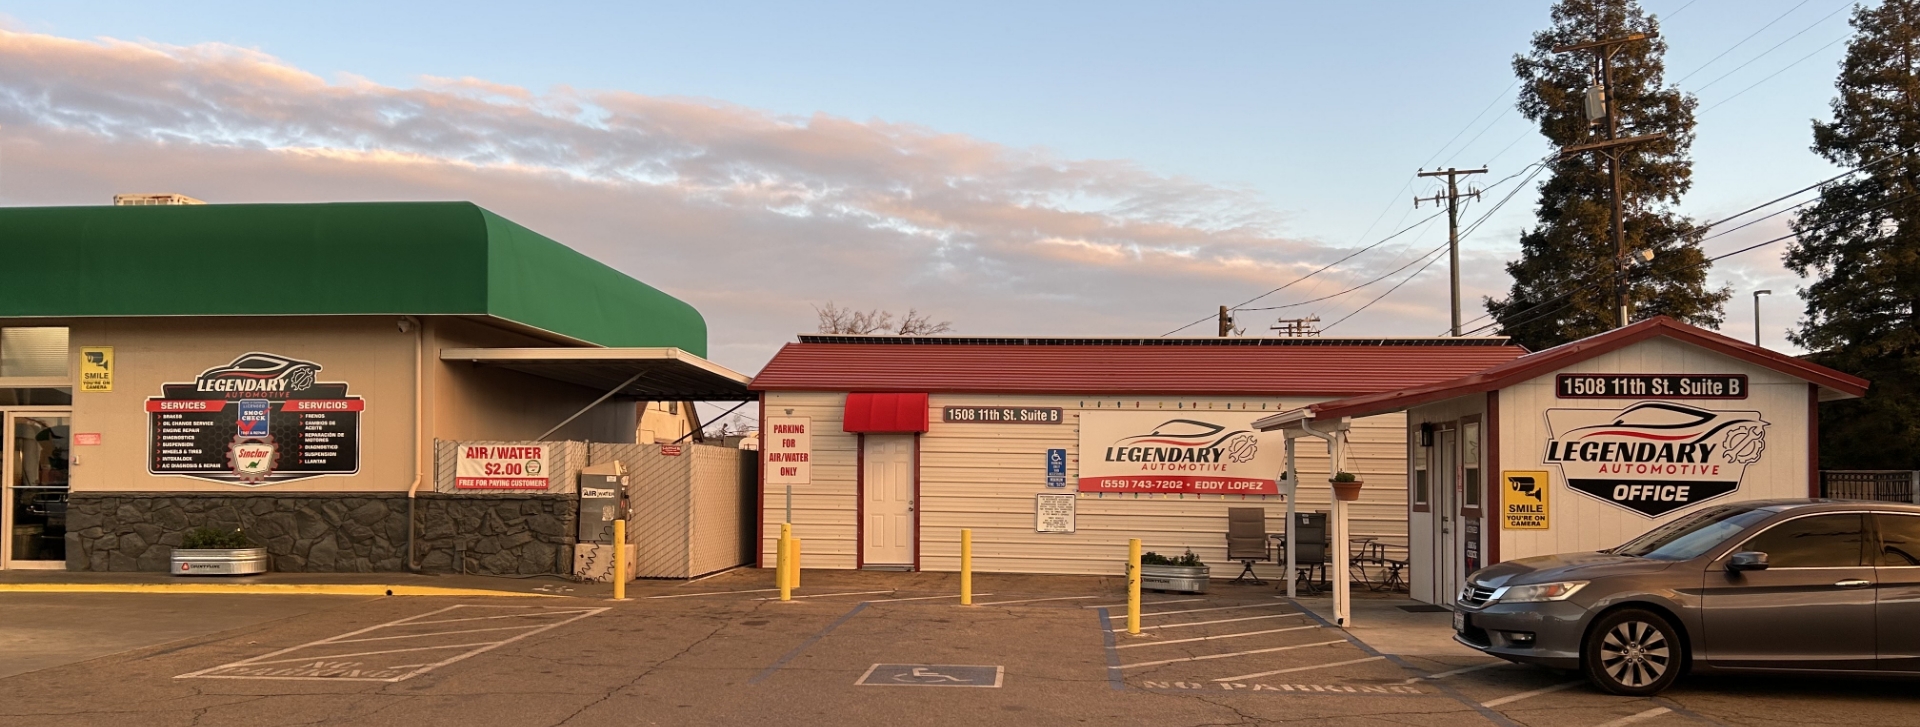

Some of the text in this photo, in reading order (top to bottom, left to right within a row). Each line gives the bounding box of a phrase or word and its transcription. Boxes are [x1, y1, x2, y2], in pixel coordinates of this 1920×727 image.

[84, 372, 109, 380] SMILE
[196, 378, 289, 392] LEGENDARY
[1564, 378, 1740, 395] 1508 11th St. Suite B
[224, 391, 291, 399] AUTOMOTIVE
[160, 401, 207, 410] SERVICES
[298, 401, 348, 409] SERVICIOS
[948, 409, 1058, 421] 1508 11th St. Suite B
[773, 424, 805, 434] PARKING
[782, 438, 796, 448] FOR
[238, 448, 269, 458] Sinclair
[768, 452, 808, 462] AIR/WATER
[1104, 446, 1225, 463] LEGENDARY
[1547, 441, 1718, 464] LEGENDARY
[485, 462, 522, 476] $2.00
[780, 466, 797, 476] ONLY
[1141, 463, 1228, 472] AUTOMOTIVE
[1598, 463, 1720, 476] AUTOMOTIVE
[459, 479, 474, 487] FREE
[476, 479, 488, 487] FOR
[511, 480, 547, 488] CUSTOMERS
[1100, 480, 1264, 490] (559) 743-7202 EDDY LOPEZ
[1612, 484, 1690, 502] OFFICE
[1508, 504, 1544, 513] SMILE
[1142, 680, 1422, 695] NO PARKING
